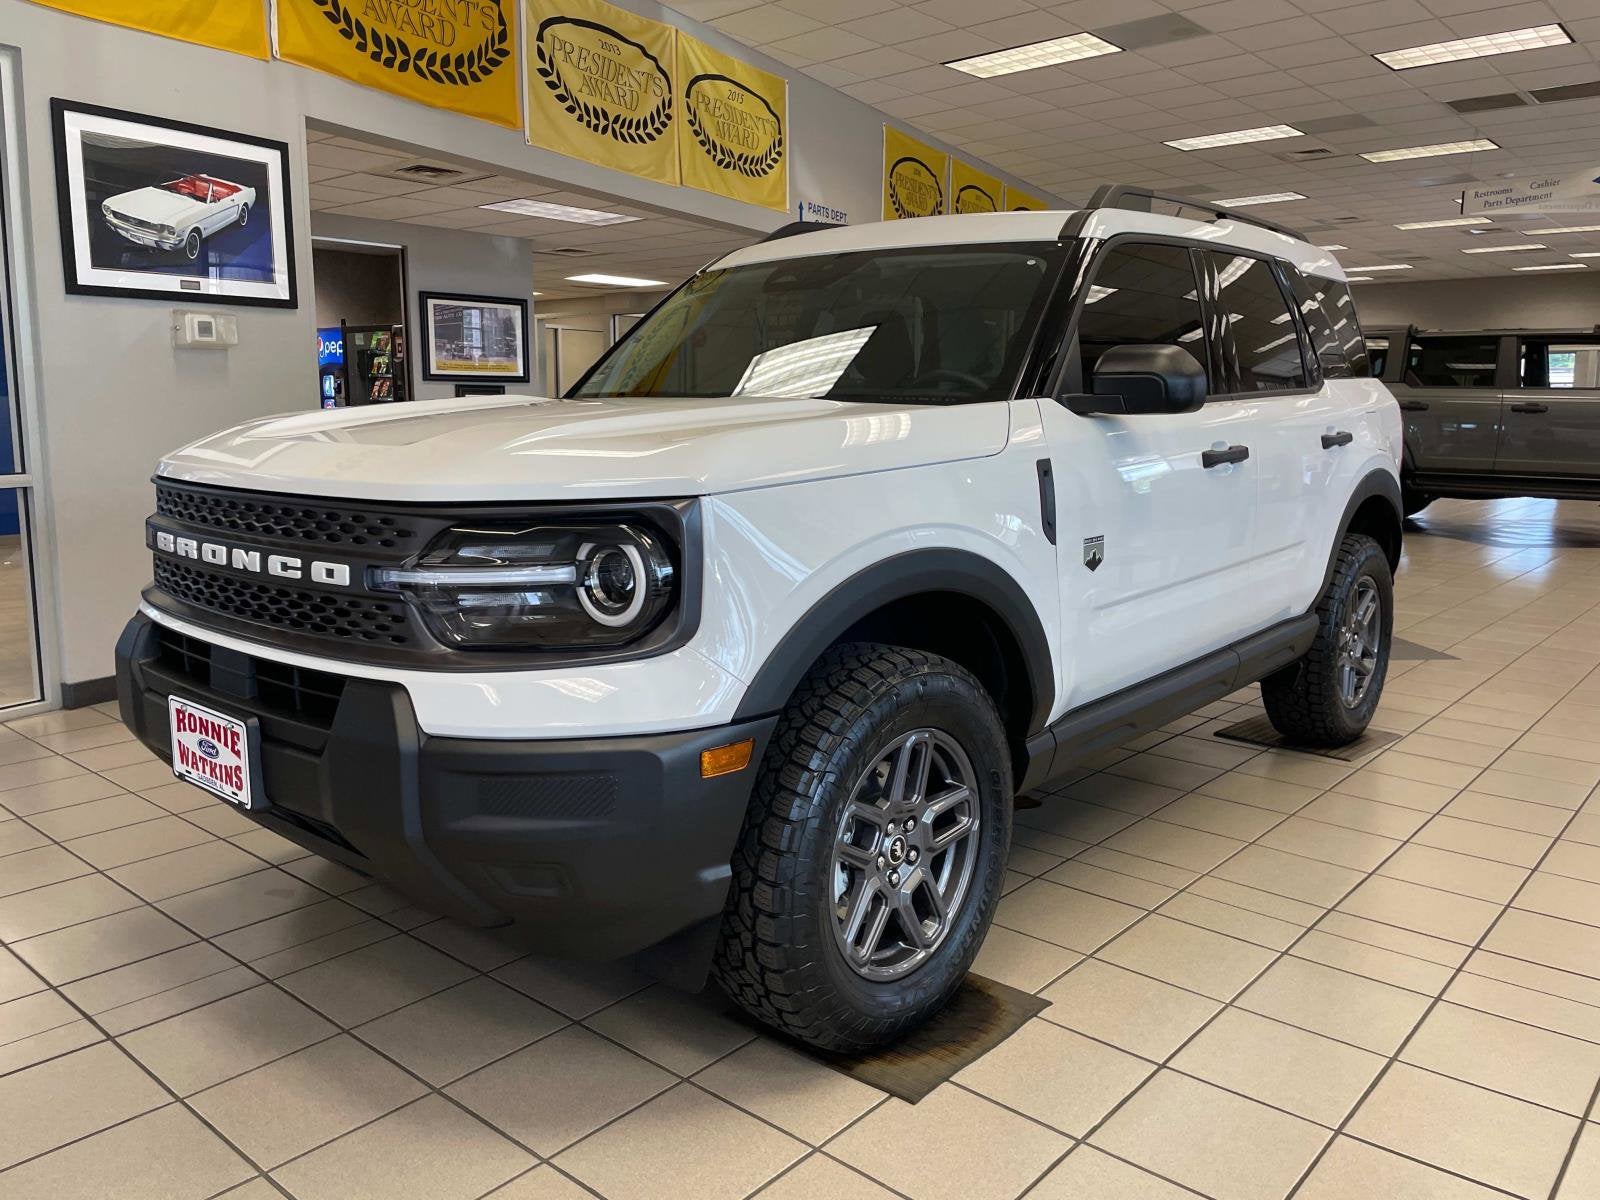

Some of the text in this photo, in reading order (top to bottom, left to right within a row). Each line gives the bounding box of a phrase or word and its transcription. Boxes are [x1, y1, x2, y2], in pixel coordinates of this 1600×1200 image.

[361, 0, 455, 47] AWARD
[551, 34, 664, 97] PRESIDENT'S
[577, 74, 640, 111] AWARD
[727, 89, 745, 104] 2015
[695, 90, 777, 138] PRESIDENT'S
[715, 120, 760, 150] AWARD
[1474, 178, 1561, 199] Restrooms Cashier
[1483, 200, 1503, 208] Parts
[1505, 192, 1553, 206] Department
[808, 201, 830, 219] PARTS
[156, 531, 350, 586] BRONCO
[175, 707, 242, 760] RONNIE
[200, 740, 218, 757] Ford
[177, 739, 244, 791] WATKINS
